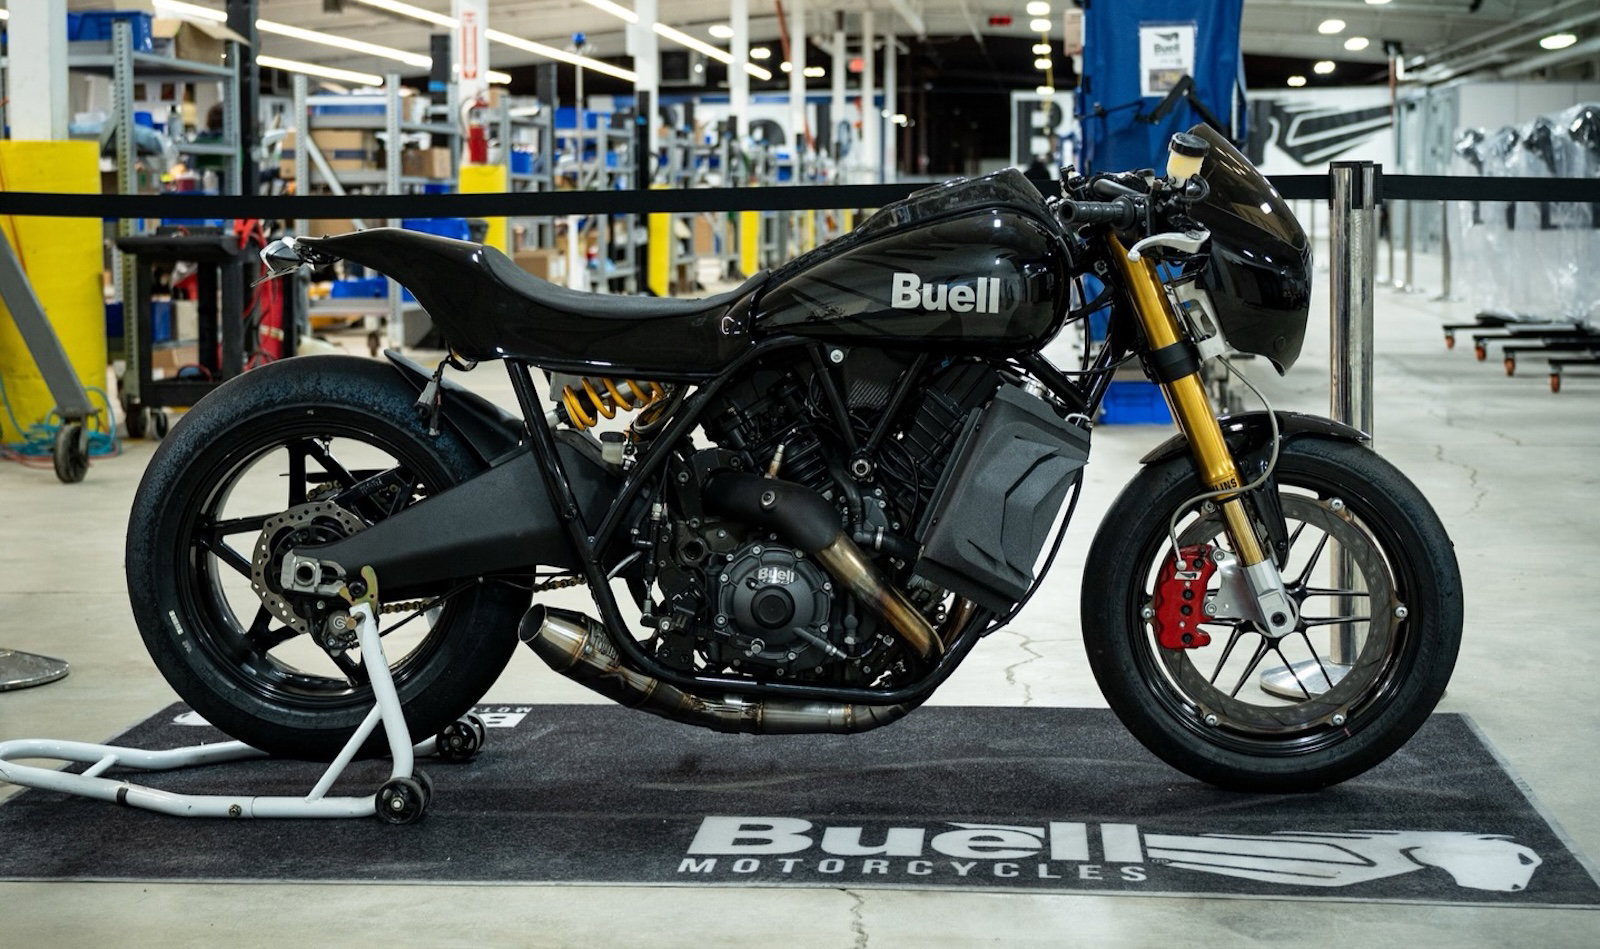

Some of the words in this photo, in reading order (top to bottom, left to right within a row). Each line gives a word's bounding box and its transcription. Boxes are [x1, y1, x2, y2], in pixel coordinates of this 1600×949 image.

[891, 272, 1000, 314] Buell
[758, 566, 795, 583] Buell
[686, 816, 1144, 863] Buell
[677, 857, 1147, 882] MOTORCYCLES
